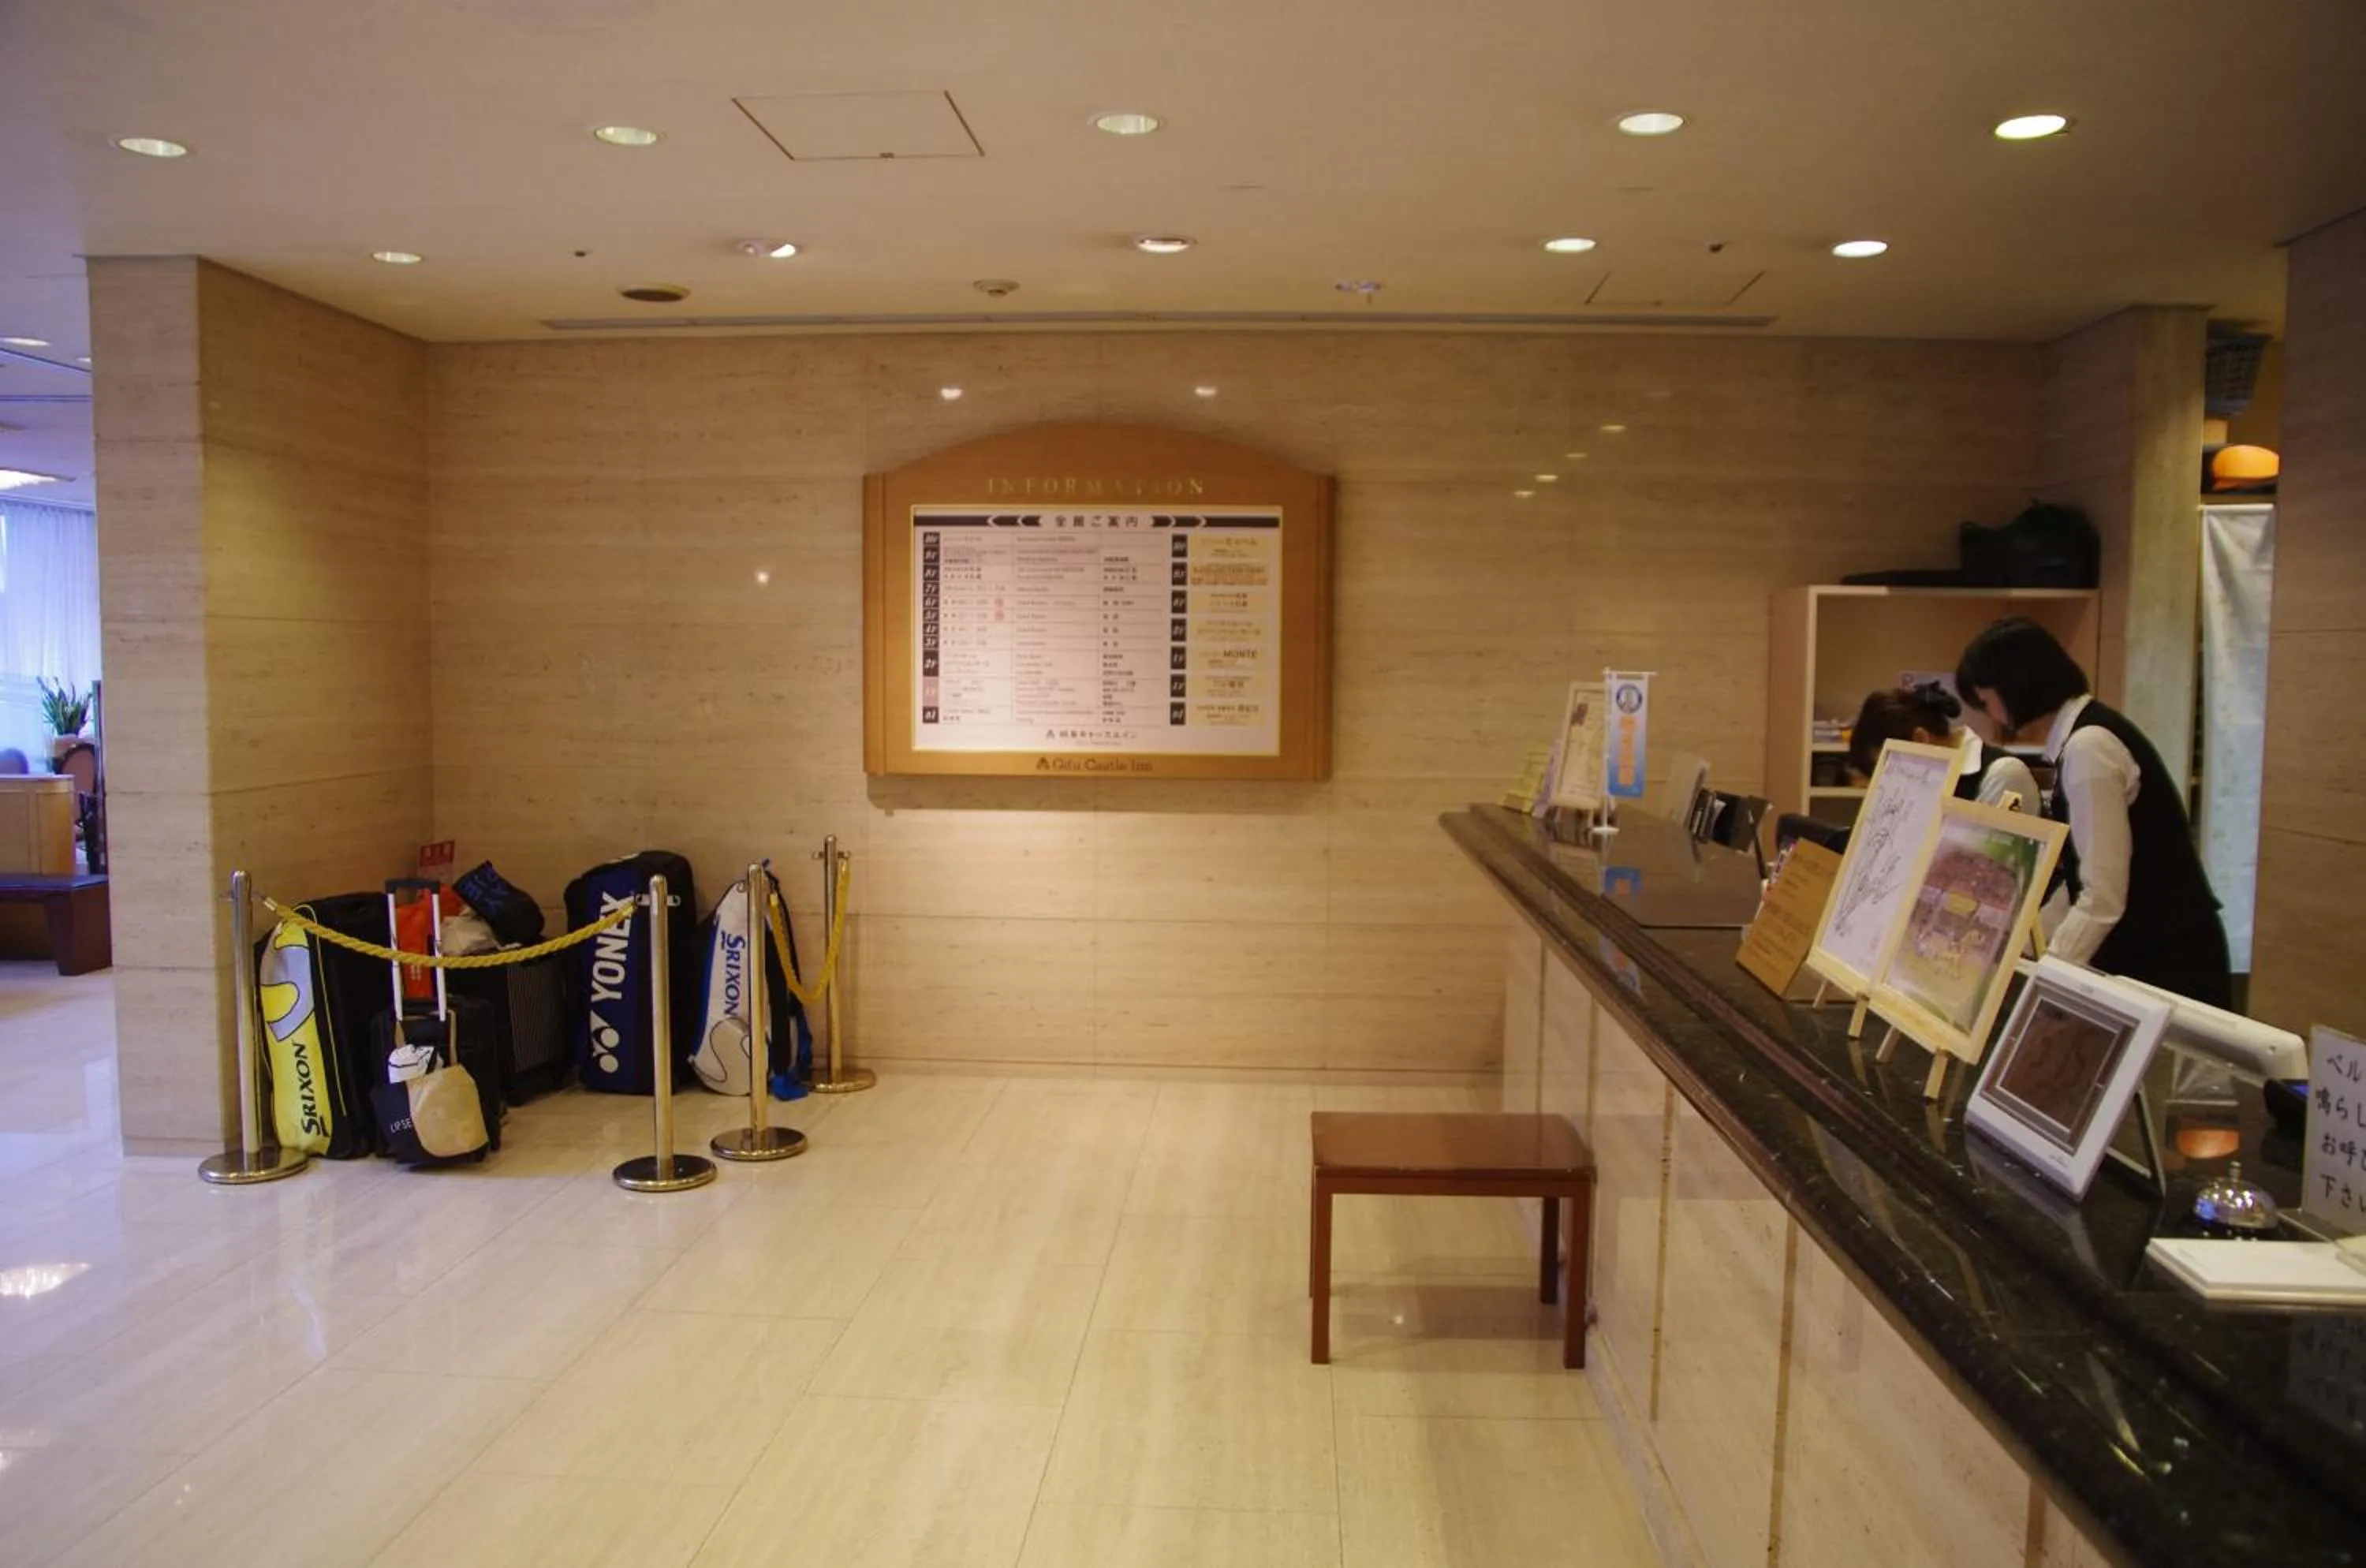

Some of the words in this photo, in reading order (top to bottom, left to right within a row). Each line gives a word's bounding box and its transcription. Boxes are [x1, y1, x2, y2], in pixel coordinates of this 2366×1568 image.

[987, 477, 1204, 496] INFORMATION
[1054, 515, 1139, 528] 全館ご案内
[1052, 757, 1081, 771] Gifu
[1084, 758, 1127, 771] Castle
[1131, 759, 1154, 771] Inn
[591, 890, 635, 1002] YONEX
[722, 931, 746, 1016] SRIXON
[292, 1039, 327, 1137] SRIXON
